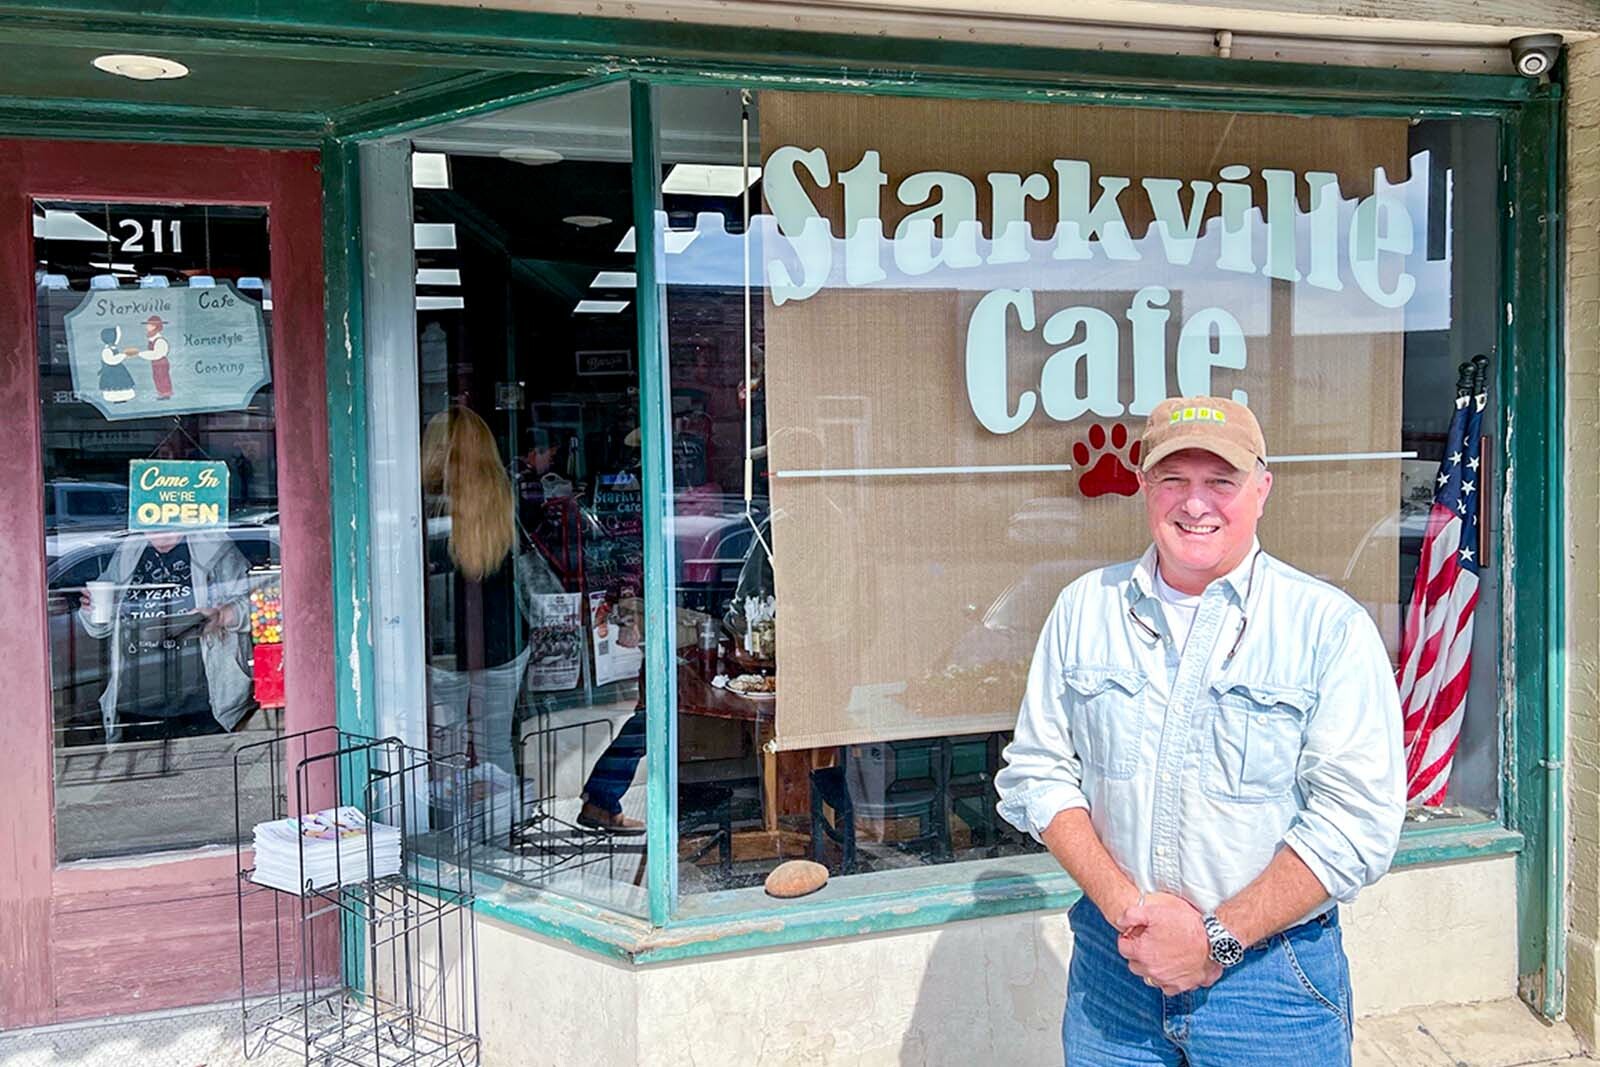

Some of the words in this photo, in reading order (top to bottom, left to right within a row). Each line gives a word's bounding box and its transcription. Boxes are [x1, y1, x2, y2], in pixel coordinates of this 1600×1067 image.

[119, 218, 182, 252] 211
[762, 145, 1416, 309] Starkville
[96, 299, 171, 316] Starkville
[199, 291, 235, 309] Cafe
[184, 332, 243, 348] Homestyle
[195, 361, 245, 376] Cooking
[965, 285, 1249, 435] Cafe
[140, 466, 189, 490] Come
[193, 468, 220, 488] In
[159, 491, 196, 502] WE'RE
[137, 502, 219, 526] OPEN
[145, 585, 191, 600] YEARS
